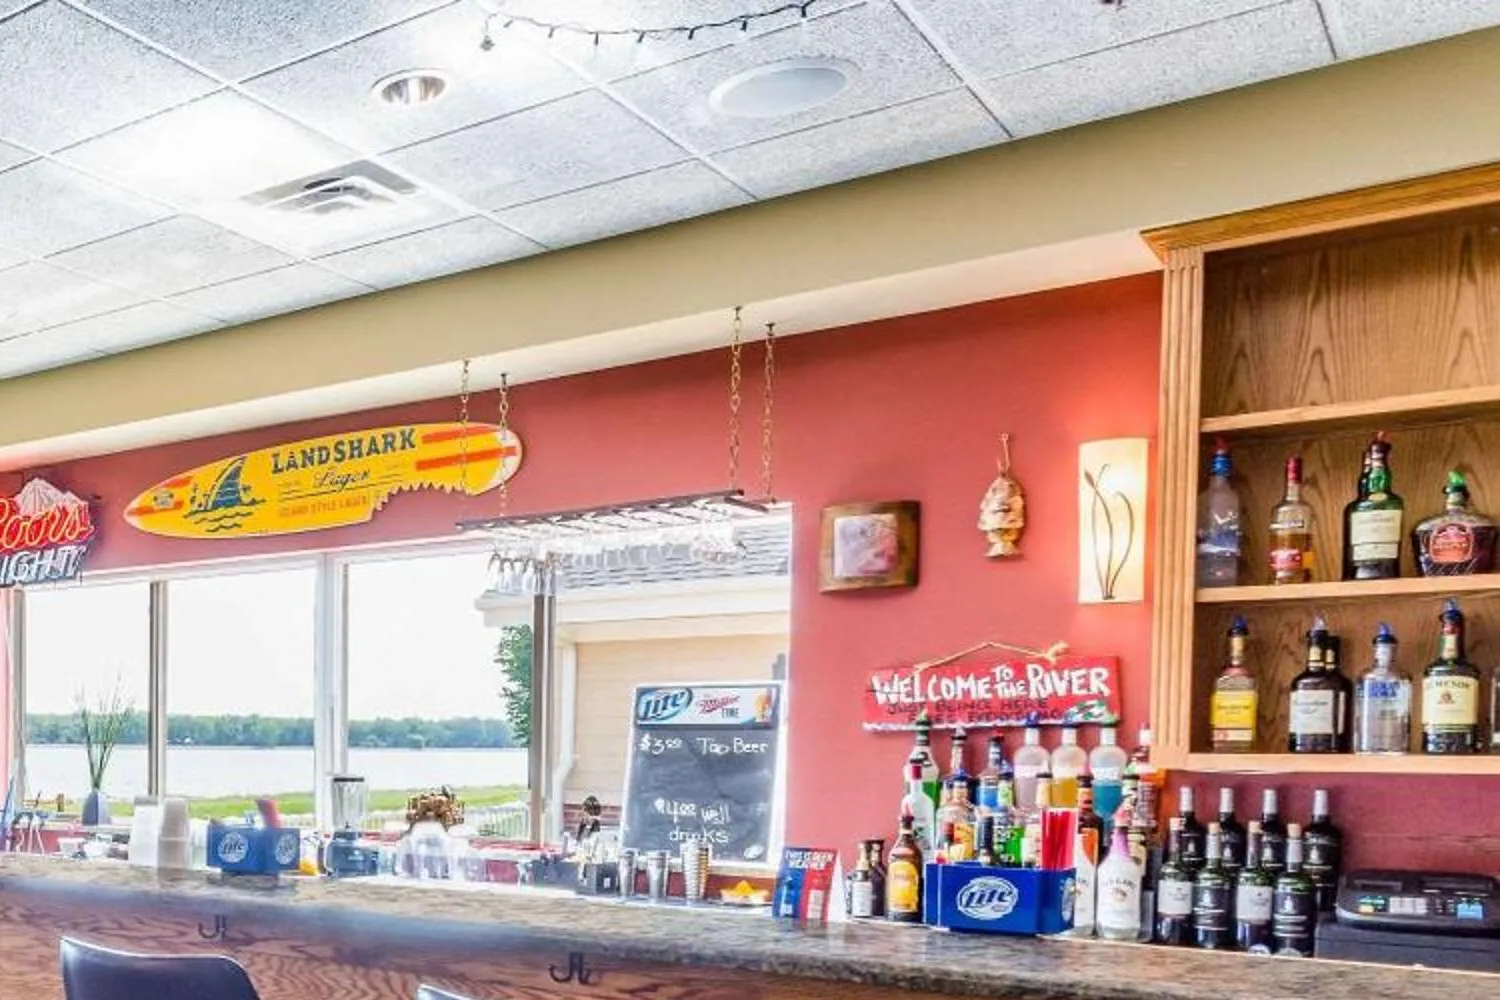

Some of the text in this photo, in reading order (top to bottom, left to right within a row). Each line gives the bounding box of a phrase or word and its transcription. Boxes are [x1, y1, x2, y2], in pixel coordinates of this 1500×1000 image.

[271, 428, 416, 474] LANDSHARK
[871, 663, 1111, 705] WELCOME TO THE RIVER
[733, 737, 768, 754] Beer
[964, 888, 1014, 909] Lite
